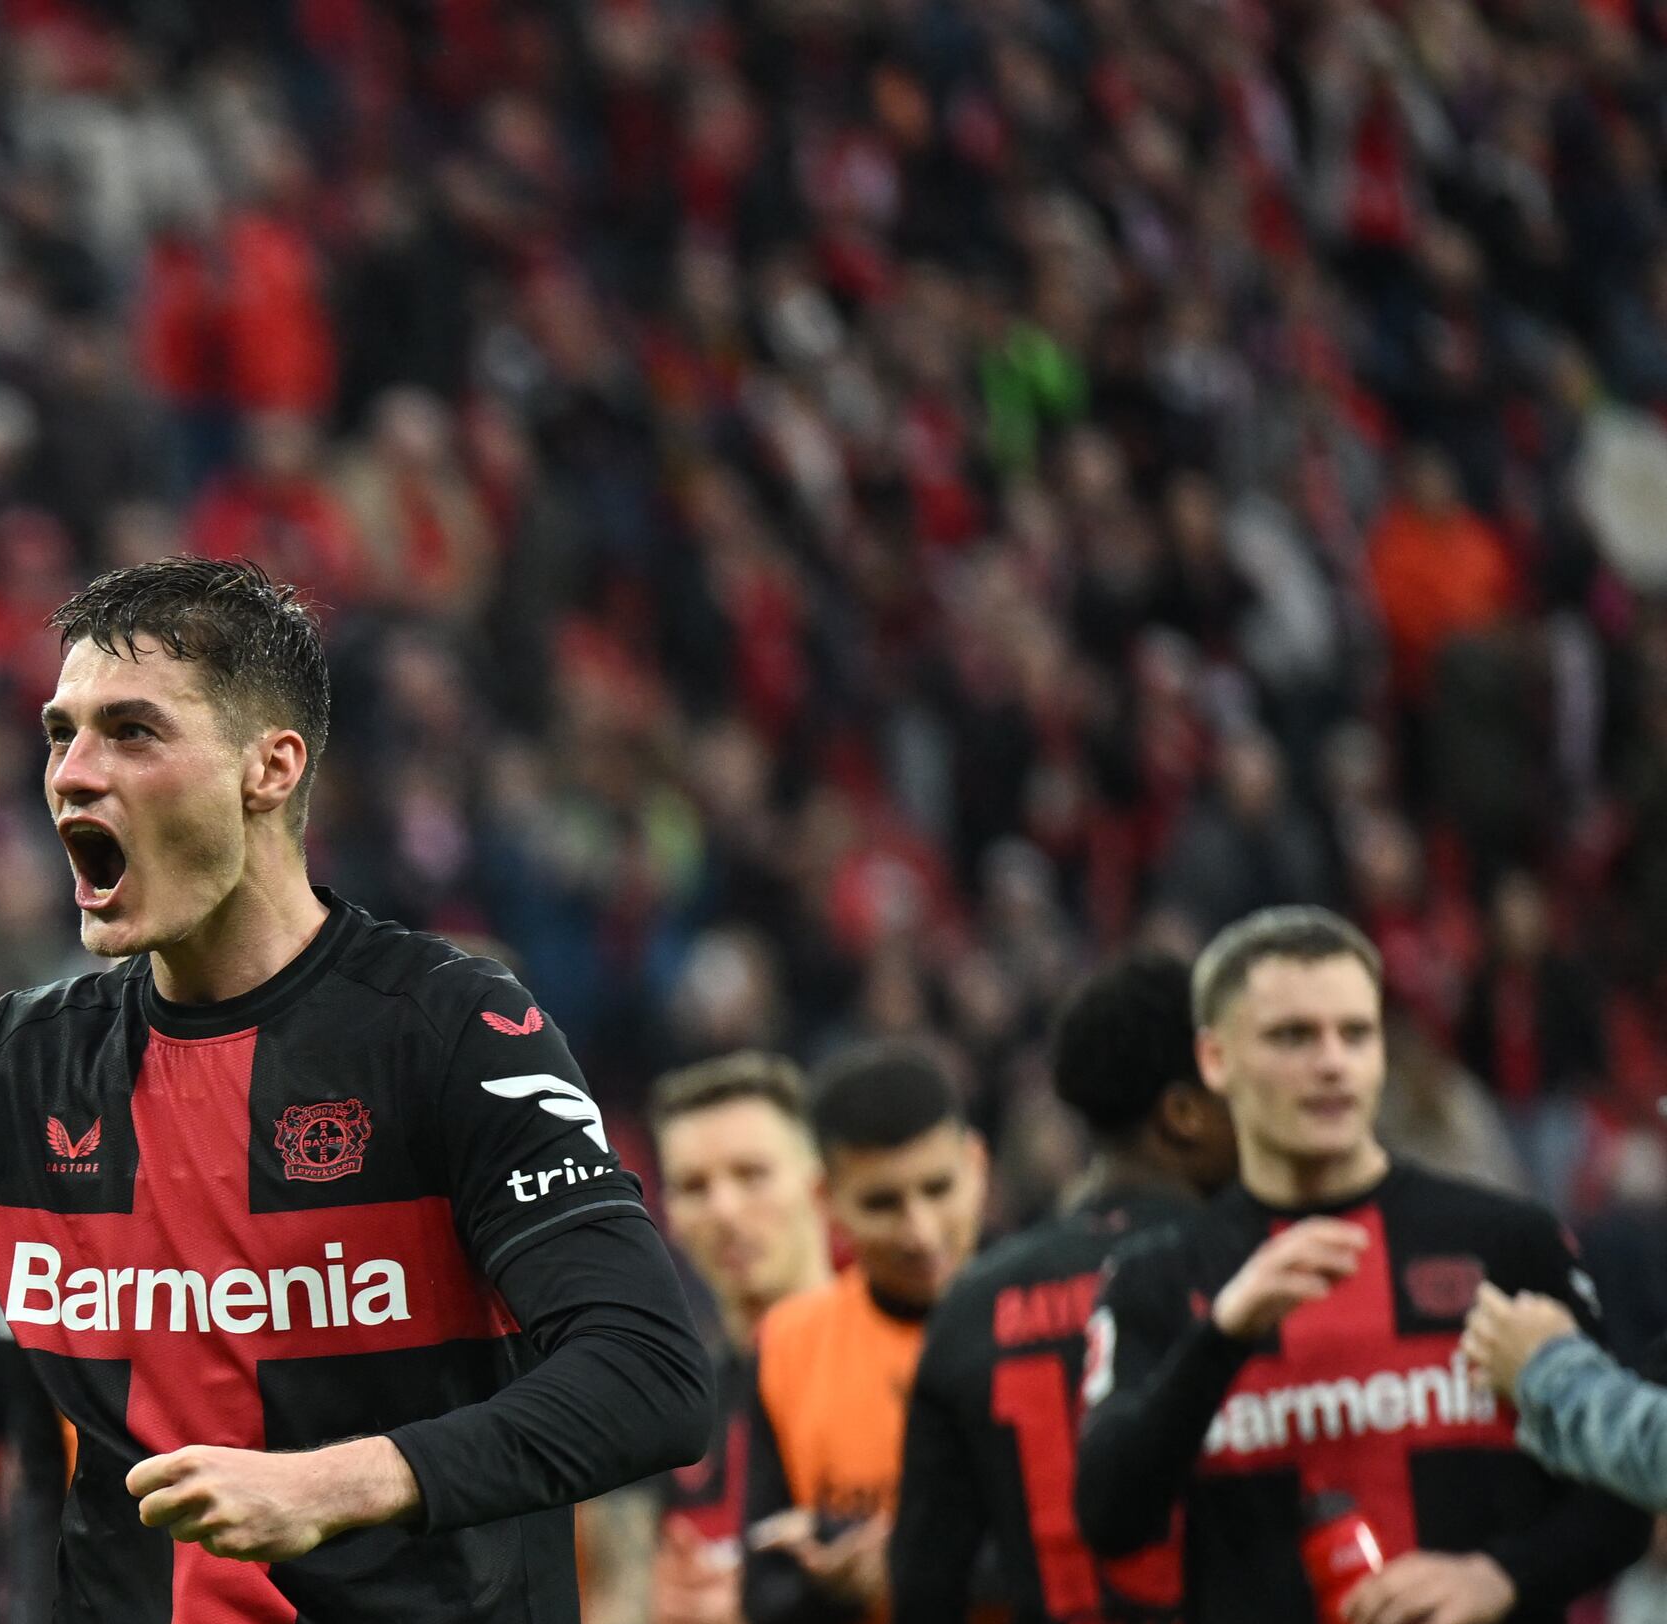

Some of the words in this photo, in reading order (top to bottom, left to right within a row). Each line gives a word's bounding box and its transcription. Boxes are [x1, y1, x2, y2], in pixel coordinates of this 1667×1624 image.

[303, 1136, 344, 1148] BAYER
[46, 1163, 99, 1173] CASTORE
[291, 1161, 357, 1177] Leverkusen
[507, 1158, 614, 1202] triv
[5, 1241, 412, 1334] Barmenia
